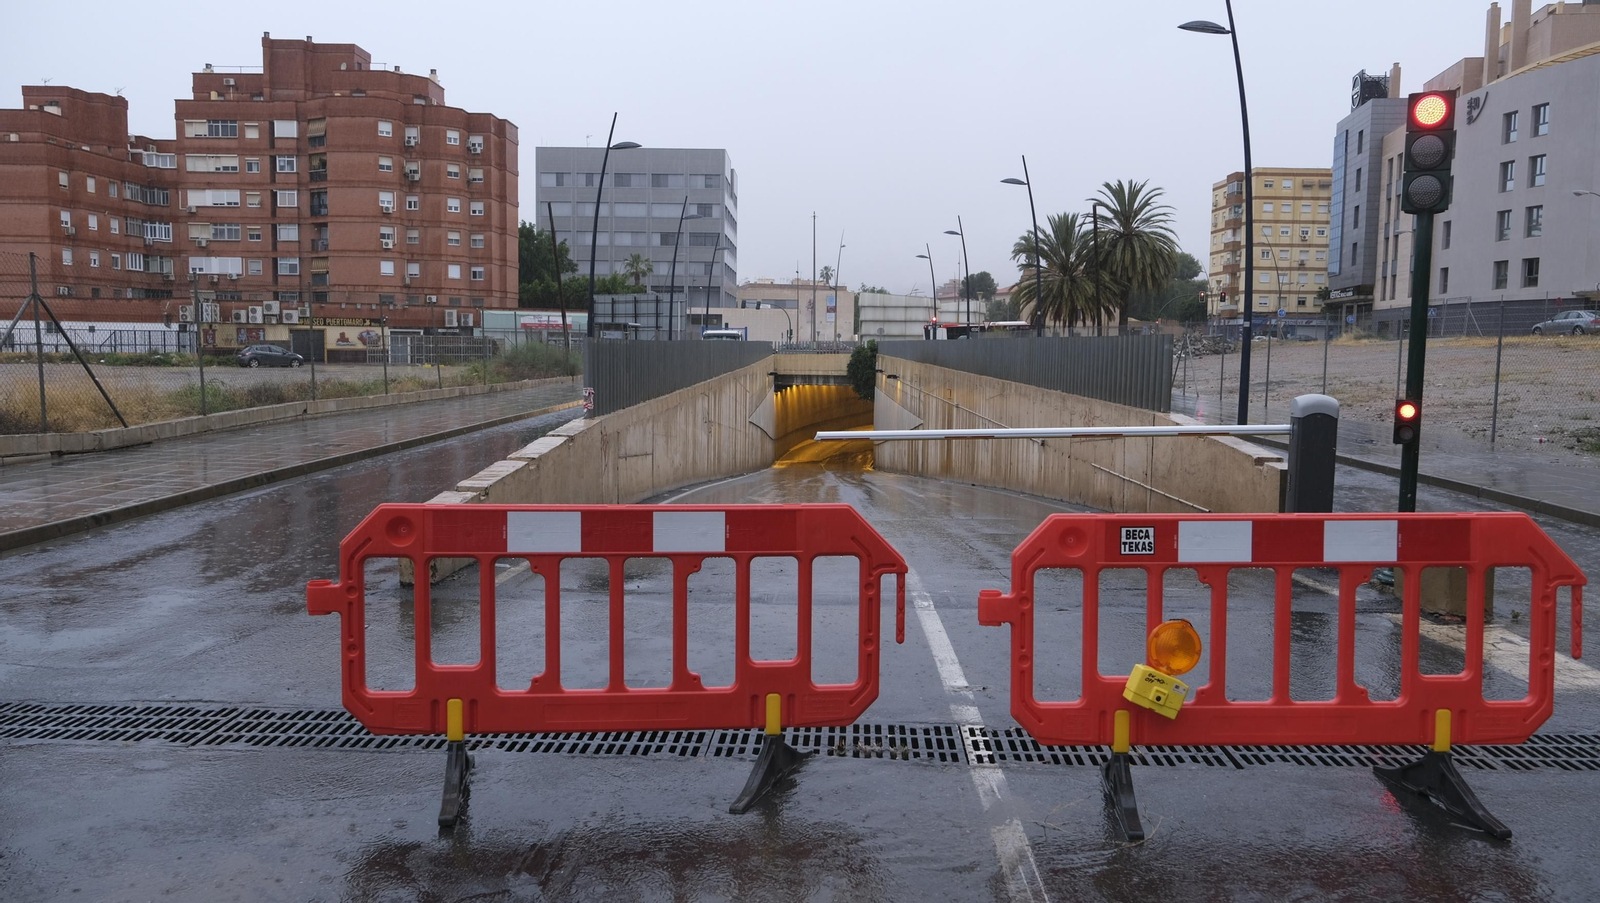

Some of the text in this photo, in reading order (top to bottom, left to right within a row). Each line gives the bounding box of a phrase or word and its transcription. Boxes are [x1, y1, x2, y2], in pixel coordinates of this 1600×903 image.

[304, 318, 323, 326] MSEO
[1125, 529, 1150, 540] BECA
[1122, 541, 1153, 552] TEKAS
